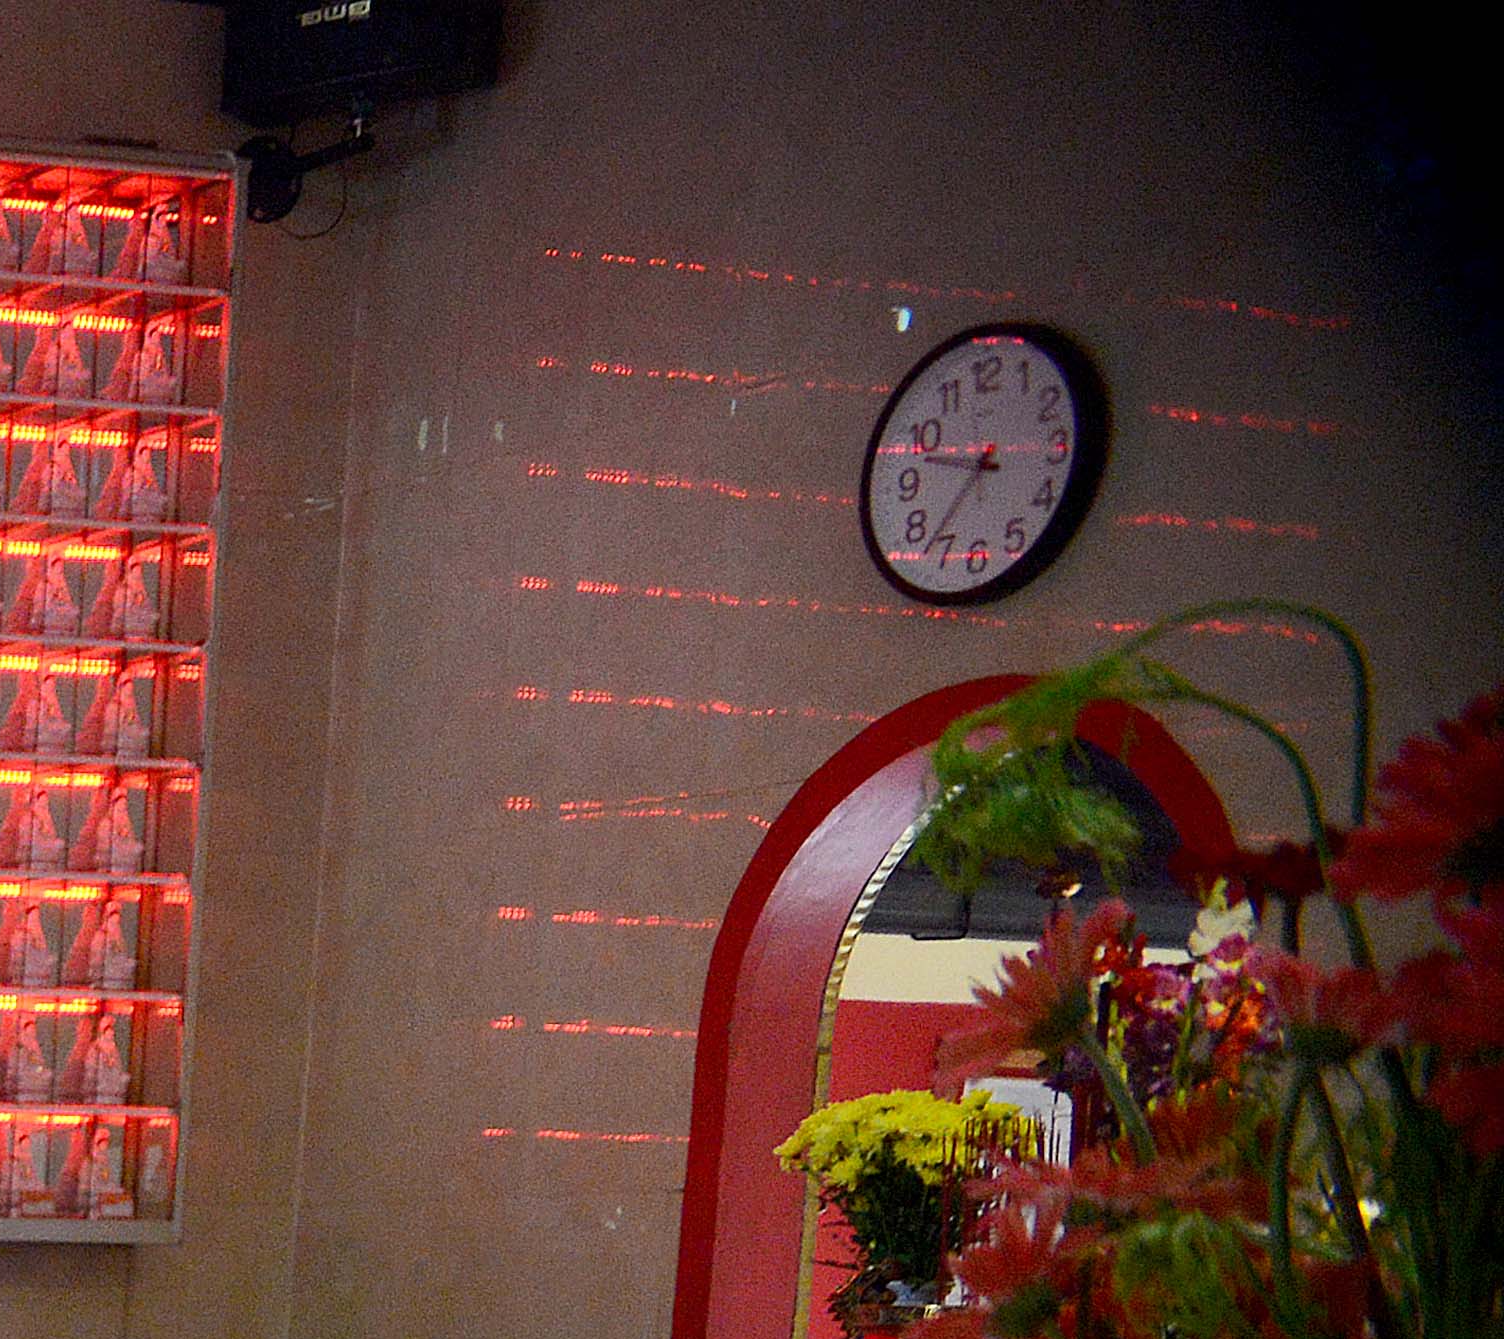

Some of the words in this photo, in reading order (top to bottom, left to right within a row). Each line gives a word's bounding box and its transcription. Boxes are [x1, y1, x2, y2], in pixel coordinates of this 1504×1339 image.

[972, 356, 1002, 391] 12
[1020, 361, 1030, 393] 1
[940, 380, 961, 413] 11
[1040, 386, 1060, 422] 2
[911, 418, 941, 452] 10
[1048, 430, 1068, 465] 3
[899, 467, 920, 501] 9
[1032, 479, 1054, 509] 4
[906, 509, 927, 543] 8
[1004, 517, 1025, 553] 5
[936, 534, 955, 569] 7
[966, 540, 988, 573] 6
